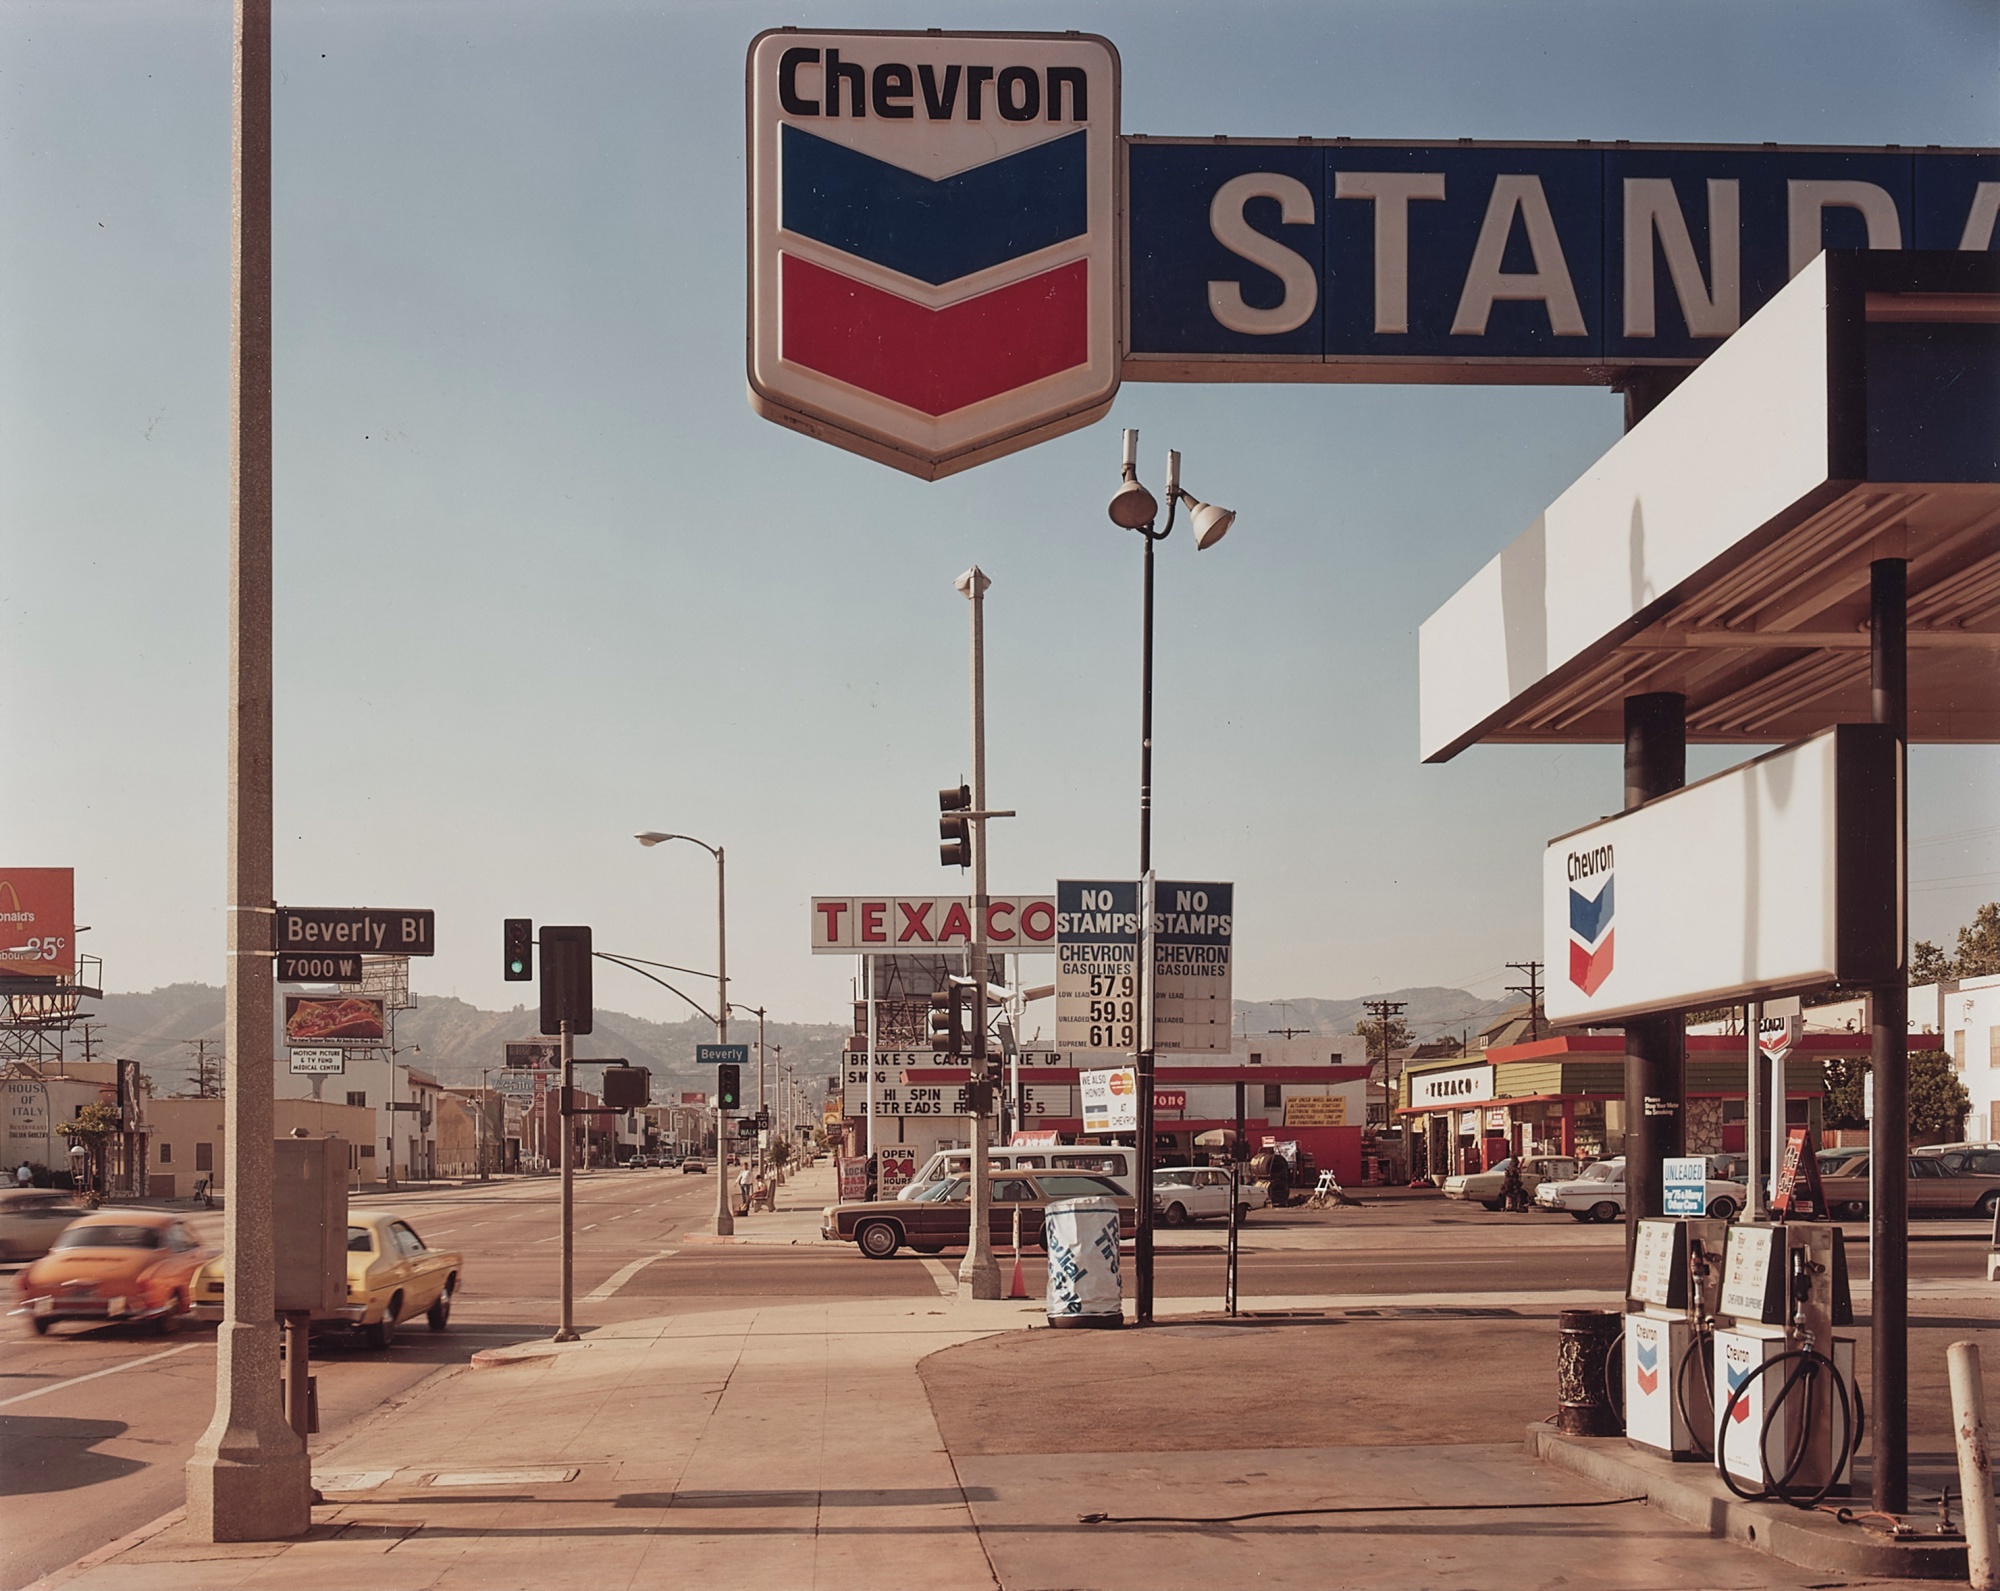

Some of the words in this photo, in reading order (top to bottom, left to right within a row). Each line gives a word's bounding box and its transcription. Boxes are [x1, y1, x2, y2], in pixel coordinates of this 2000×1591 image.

[779, 47, 1088, 122] Chevron
[1567, 844, 1614, 882] Chevron
[1081, 889, 1113, 911] NO
[1176, 890, 1208, 912] NO
[817, 901, 1055, 942] TEXACO
[1057, 912, 1137, 934] STAMPS
[1154, 913, 1231, 936] STAMPS
[288, 916, 387, 949] Beverly
[402, 918, 425, 942] Bl
[1060, 945, 1134, 962] CHEVRON
[1155, 945, 1229, 963] CHEVRON
[286, 959, 334, 977] 7000
[339, 959, 352, 976] W
[1063, 963, 1131, 975] GASOLINES
[1157, 963, 1226, 977] GASOLINES
[1090, 974, 1134, 998] 57.9
[1090, 1000, 1134, 1023] 59.9
[1058, 1040, 1087, 1048] SUPREME
[1090, 1025, 1134, 1047] 61.9
[701, 1048, 743, 1061] Beverly
[850, 1053, 916, 1066] BRAKES
[1045, 1055, 1061, 1066] UP
[1082, 1076, 1091, 1086] WE
[1092, 1074, 1106, 1085] ALSO
[1430, 1078, 1472, 1098] TEXACO
[20, 1095, 37, 1105] OF
[884, 1089, 896, 1101] HI
[910, 1088, 941, 1101] SPIN
[1085, 1087, 1106, 1098] HONOR
[1154, 1095, 1185, 1106] tone
[12, 1107, 44, 1117] ITALY
[860, 1102, 941, 1114] RETREADS
[882, 1150, 915, 1158] OPEN
[882, 1159, 915, 1178] 24
[1665, 1164, 1702, 1181] UNLEADED
[883, 1177, 912, 1185] HOURS
[844, 1185, 865, 1195] CAPS
[1636, 1324, 1658, 1341] Chevron
[1726, 1344, 1750, 1363] Chevron
